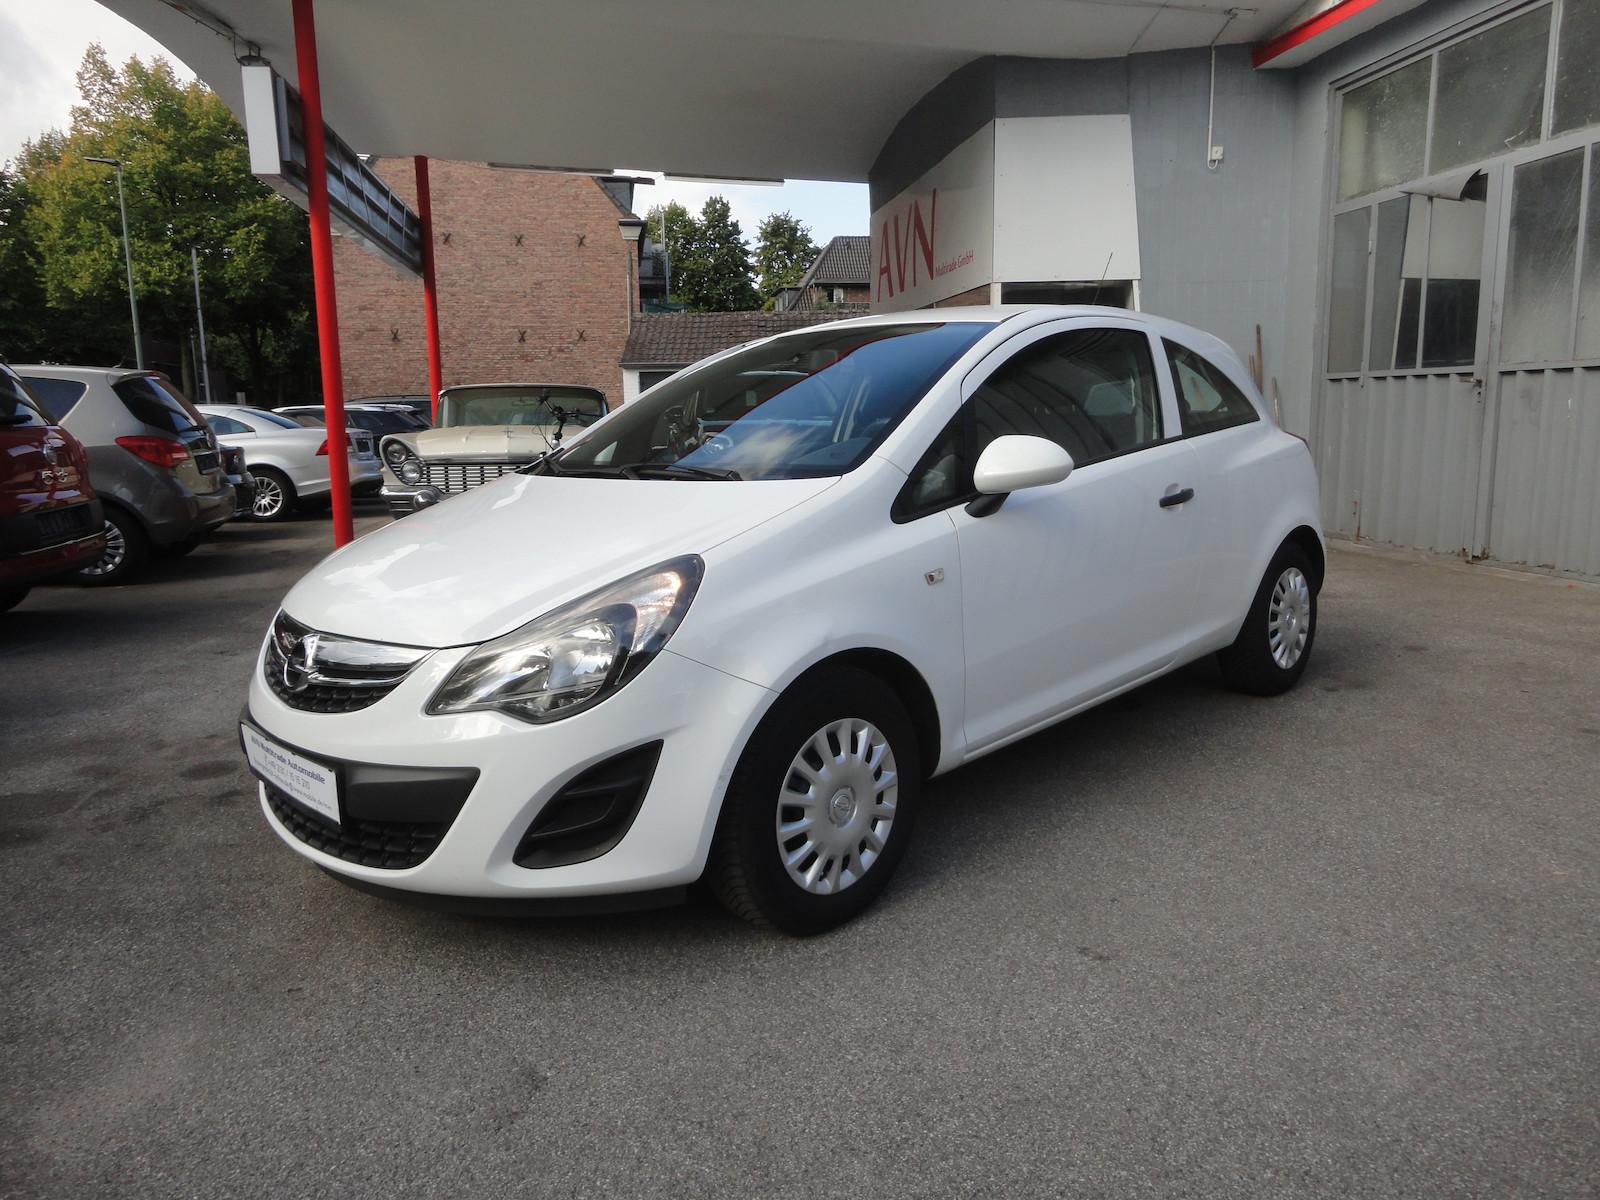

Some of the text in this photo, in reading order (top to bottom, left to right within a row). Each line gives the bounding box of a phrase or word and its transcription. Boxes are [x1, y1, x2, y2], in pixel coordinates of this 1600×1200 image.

[878, 188, 936, 303] AVN
[958, 249, 975, 268] GmbH
[288, 758, 326, 785] Automobile
